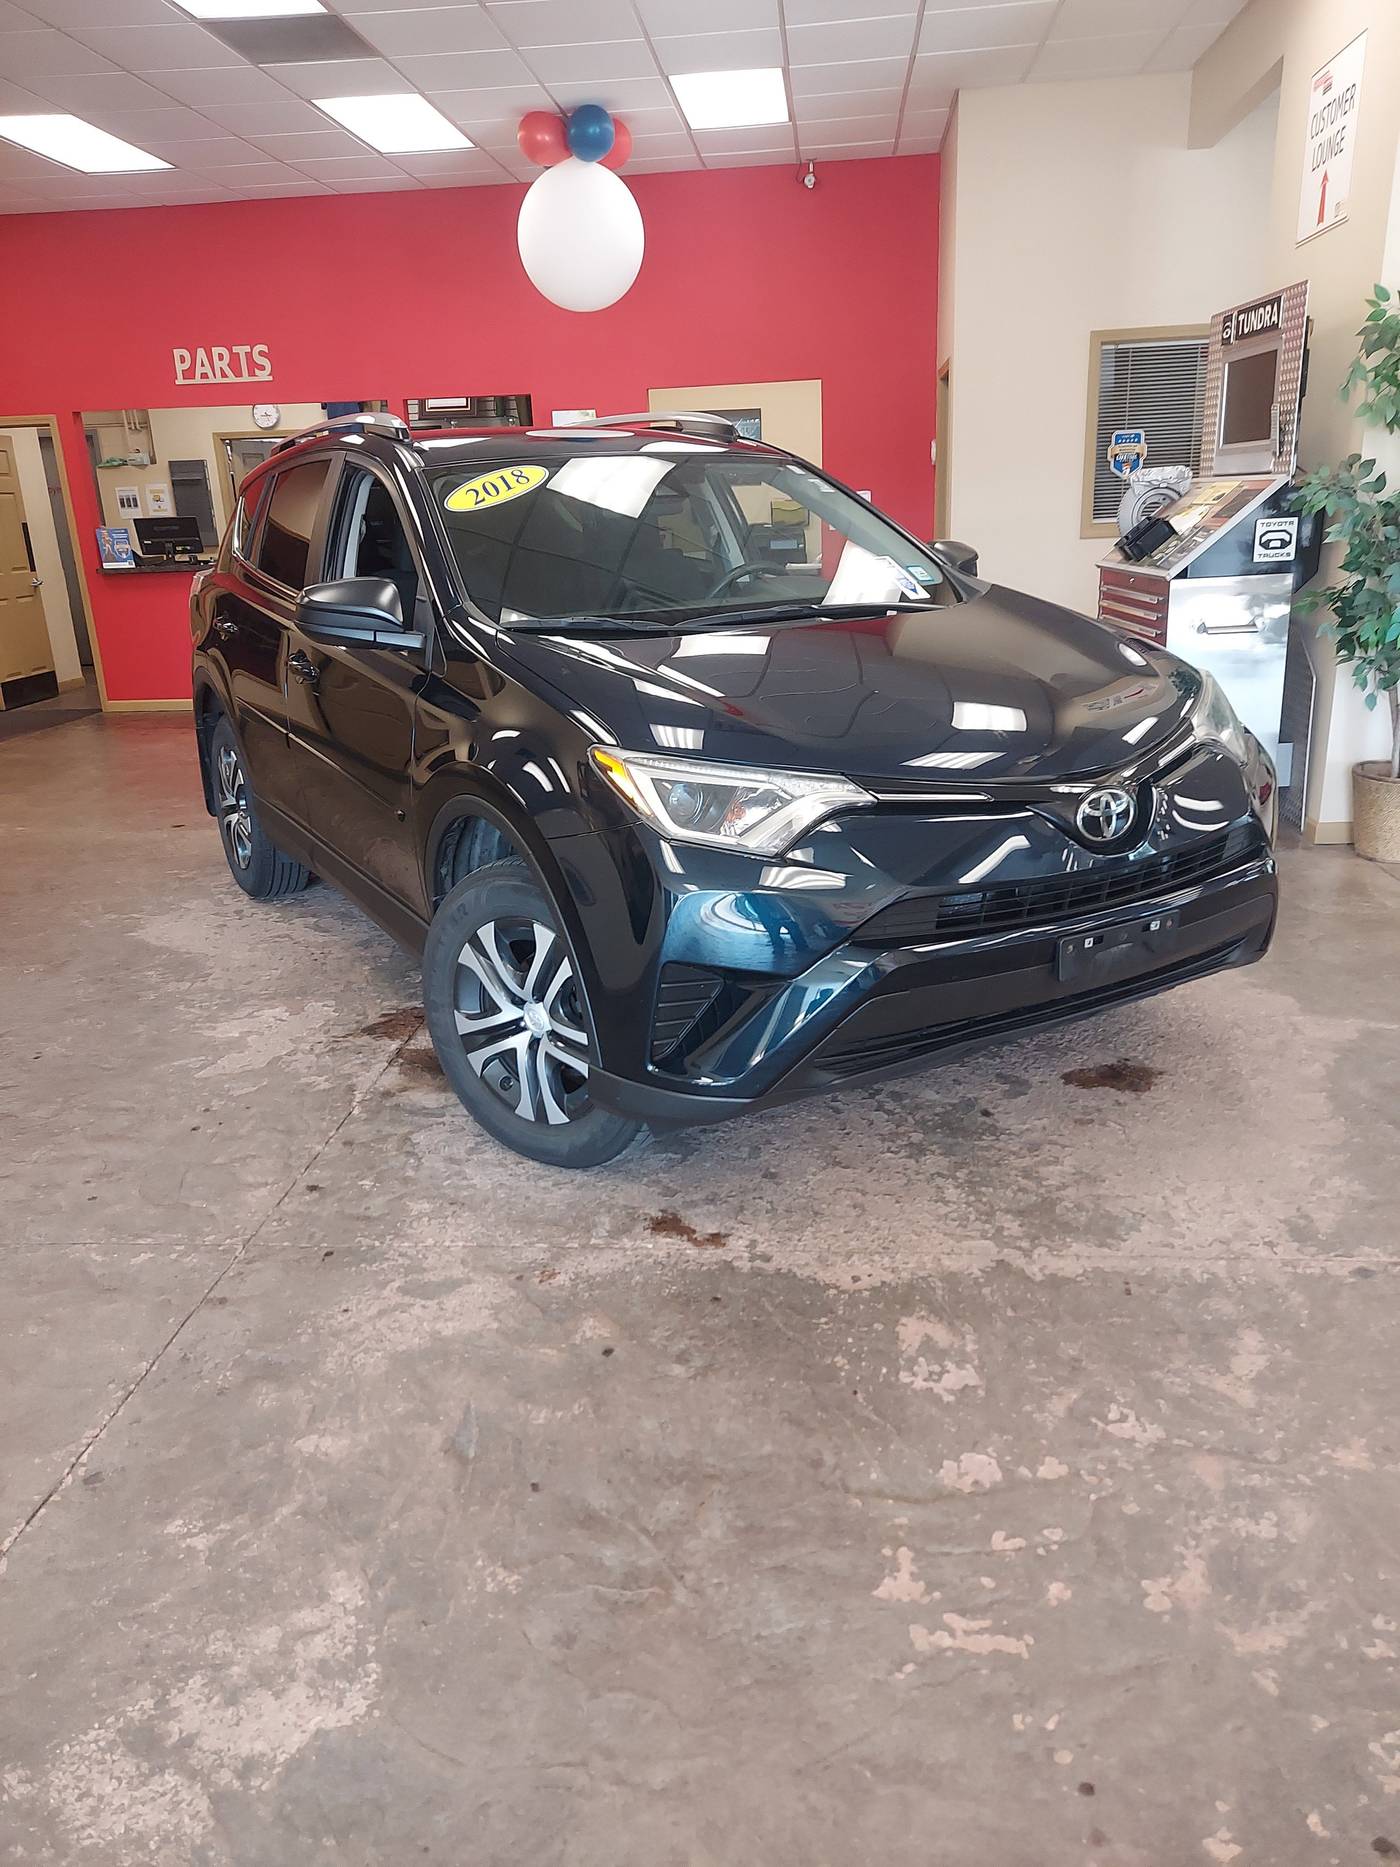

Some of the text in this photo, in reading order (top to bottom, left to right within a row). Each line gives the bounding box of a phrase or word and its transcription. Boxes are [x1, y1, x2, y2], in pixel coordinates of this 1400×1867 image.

[1310, 82, 1357, 140] CUSTOMER
[1311, 125, 1347, 172] LOUNGE
[1238, 301, 1279, 336] TUNDRA
[173, 344, 273, 384] PARTS
[465, 469, 530, 506] 2018
[1260, 520, 1295, 528] TOYOTA
[1257, 551, 1291, 559] TRUCKS
